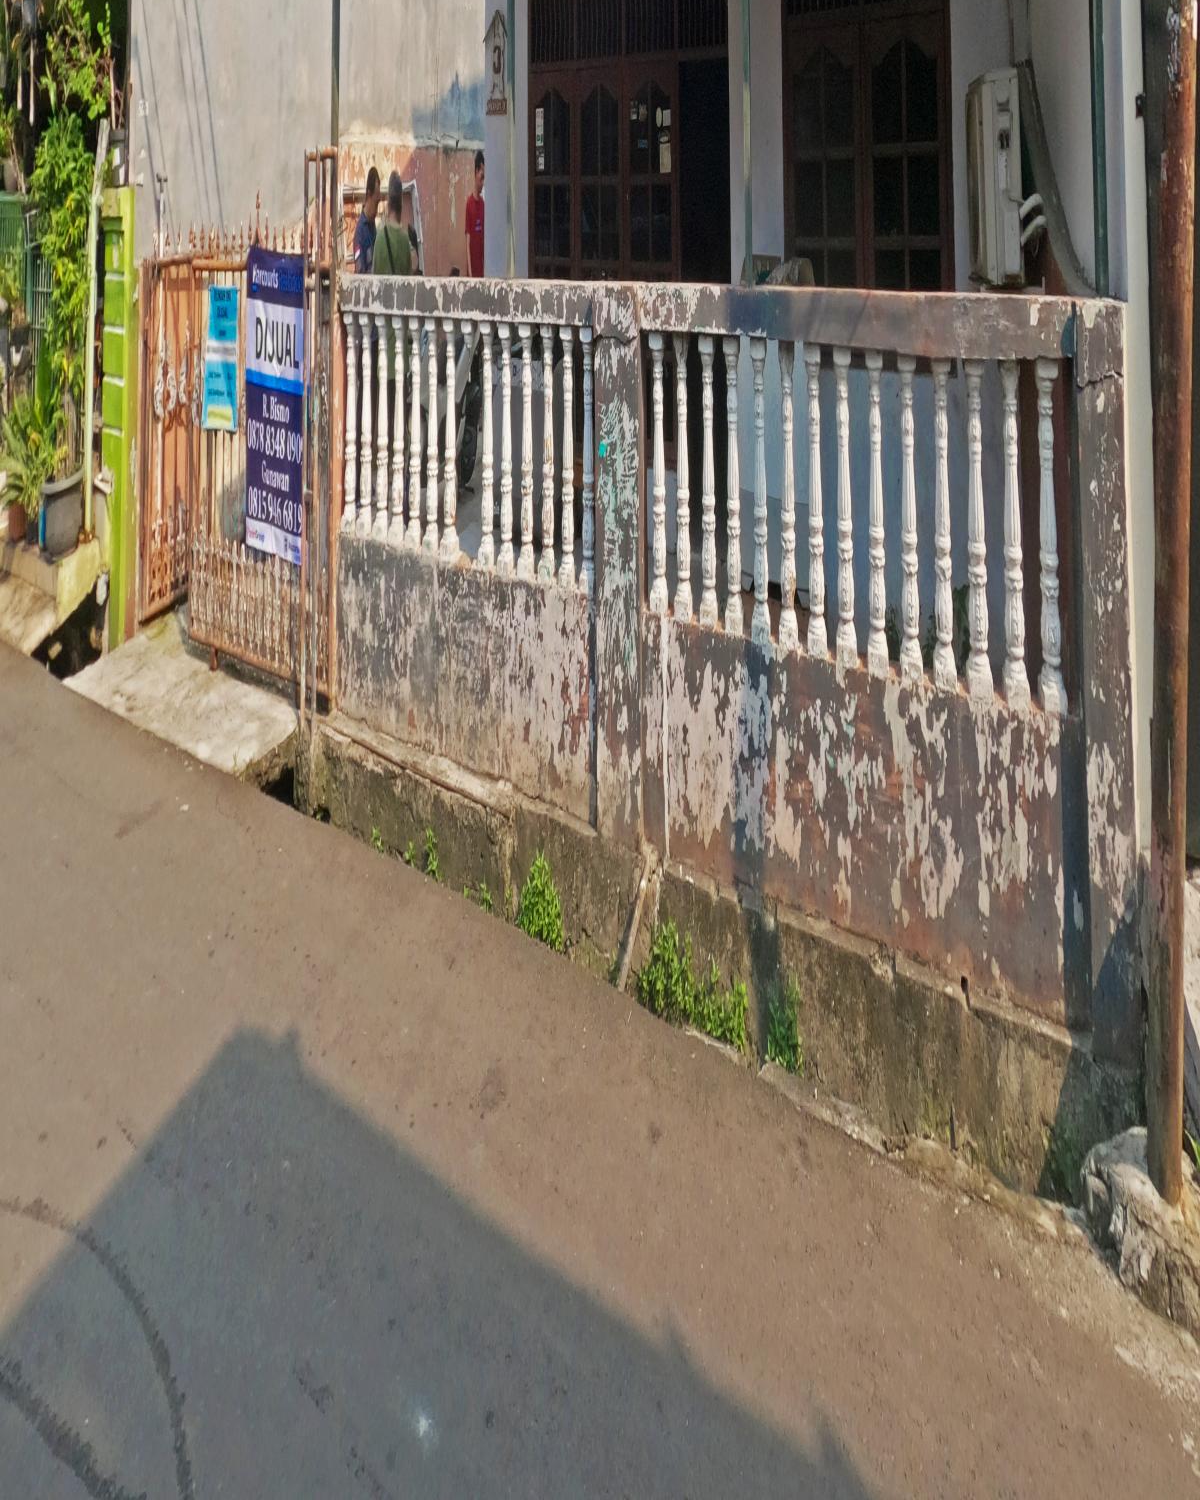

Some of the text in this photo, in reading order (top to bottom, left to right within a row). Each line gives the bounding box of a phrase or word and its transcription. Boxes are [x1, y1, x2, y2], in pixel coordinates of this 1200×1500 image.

[255, 316, 300, 369] DIJUAL
[262, 393, 269, 419] R.
[270, 396, 290, 424] Bismo
[247, 417, 264, 453] 0878
[265, 424, 286, 460] 8348
[261, 459, 290, 493] Gunawan
[248, 485, 267, 520] 0815
[267, 492, 282, 526] 946
[283, 499, 303, 535] 6819
